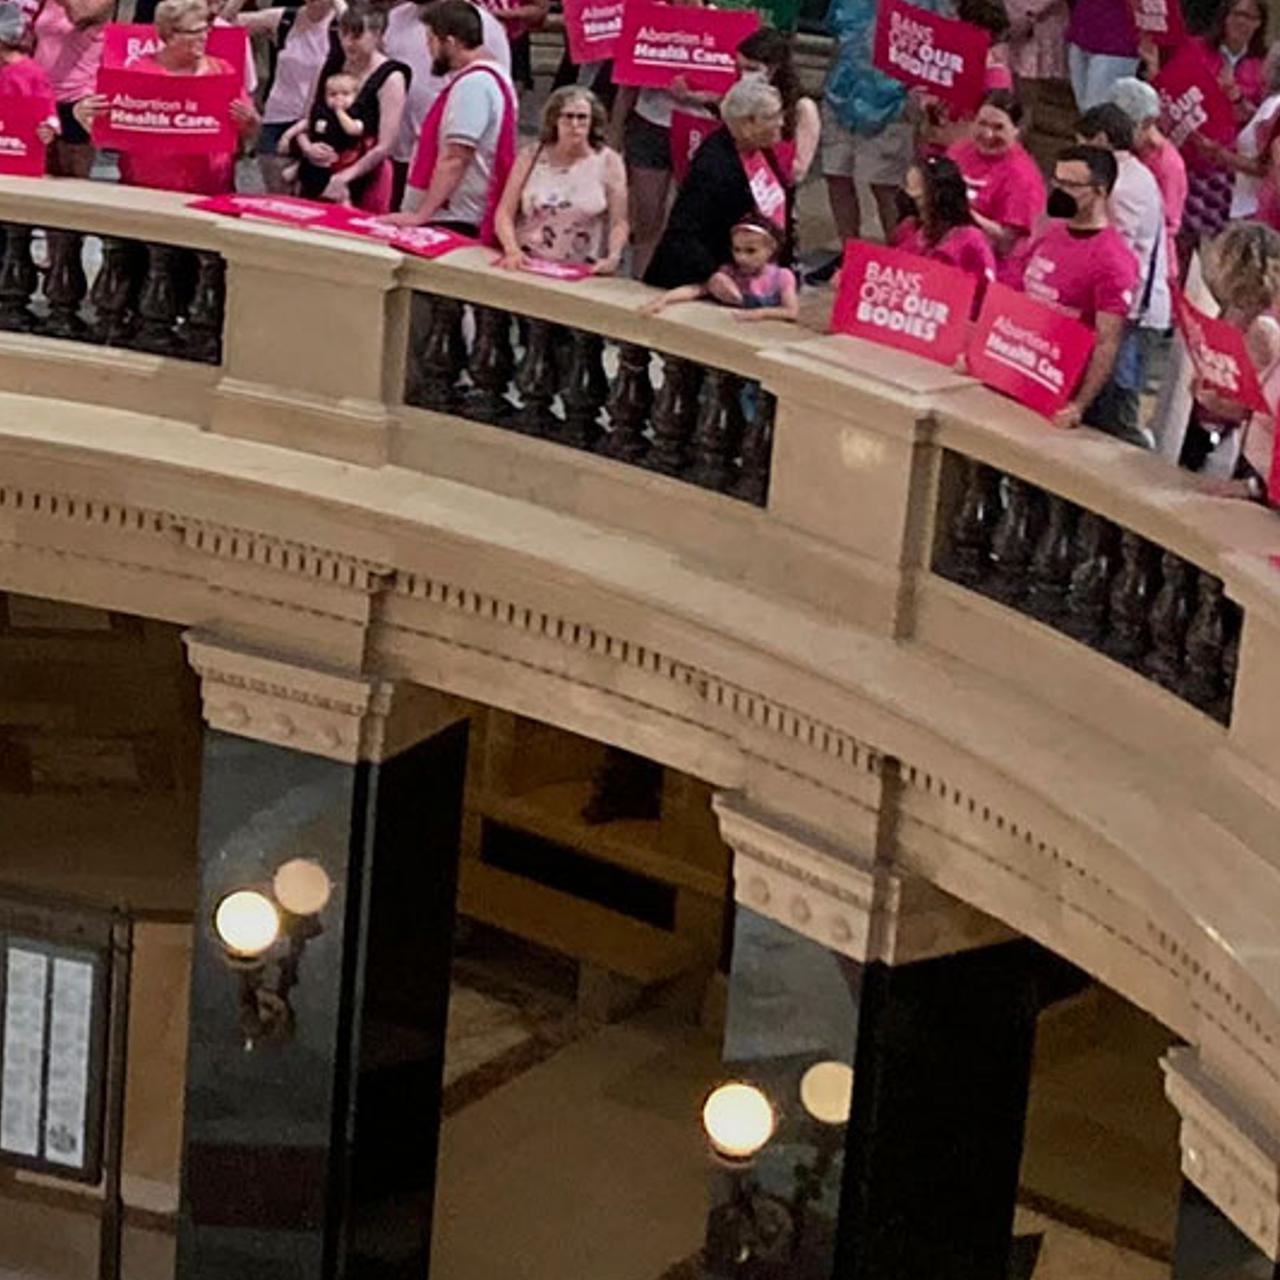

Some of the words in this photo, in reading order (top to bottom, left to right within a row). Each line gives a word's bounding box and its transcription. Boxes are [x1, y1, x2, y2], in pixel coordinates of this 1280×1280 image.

[636, 26, 701, 45] Abortion
[703, 31, 715, 47] is
[889, 10, 933, 44] BANS
[634, 43, 690, 61] Health
[888, 46, 955, 87] BODIES
[919, 43, 964, 74] OUR
[110, 108, 171, 126] Health
[111, 93, 182, 112] Abortion
[184, 98, 198, 113] is
[864, 261, 921, 291] BANS
[860, 280, 904, 309] OFF
[902, 293, 948, 325] OUR
[856, 300, 936, 341] BODIES
[991, 315, 1052, 354] Abortion
[986, 332, 1037, 369] Health
